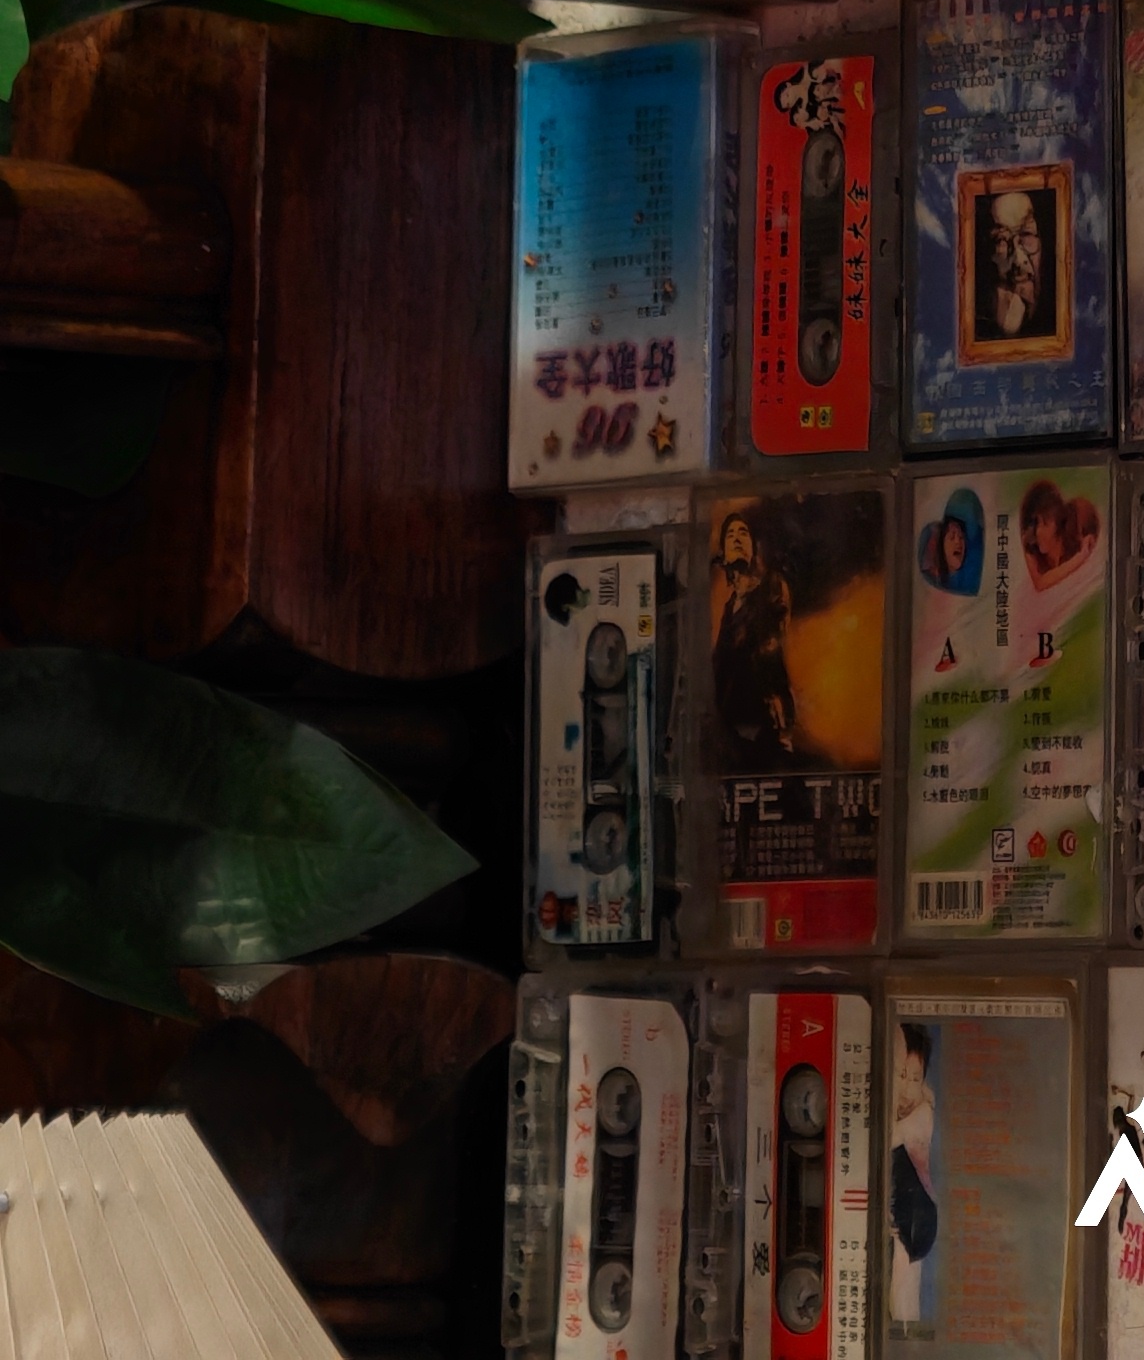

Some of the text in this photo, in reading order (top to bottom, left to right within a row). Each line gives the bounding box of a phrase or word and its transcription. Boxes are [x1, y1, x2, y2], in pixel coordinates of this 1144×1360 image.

[939, 632, 1054, 664] A B
[800, 1018, 824, 1038] A
